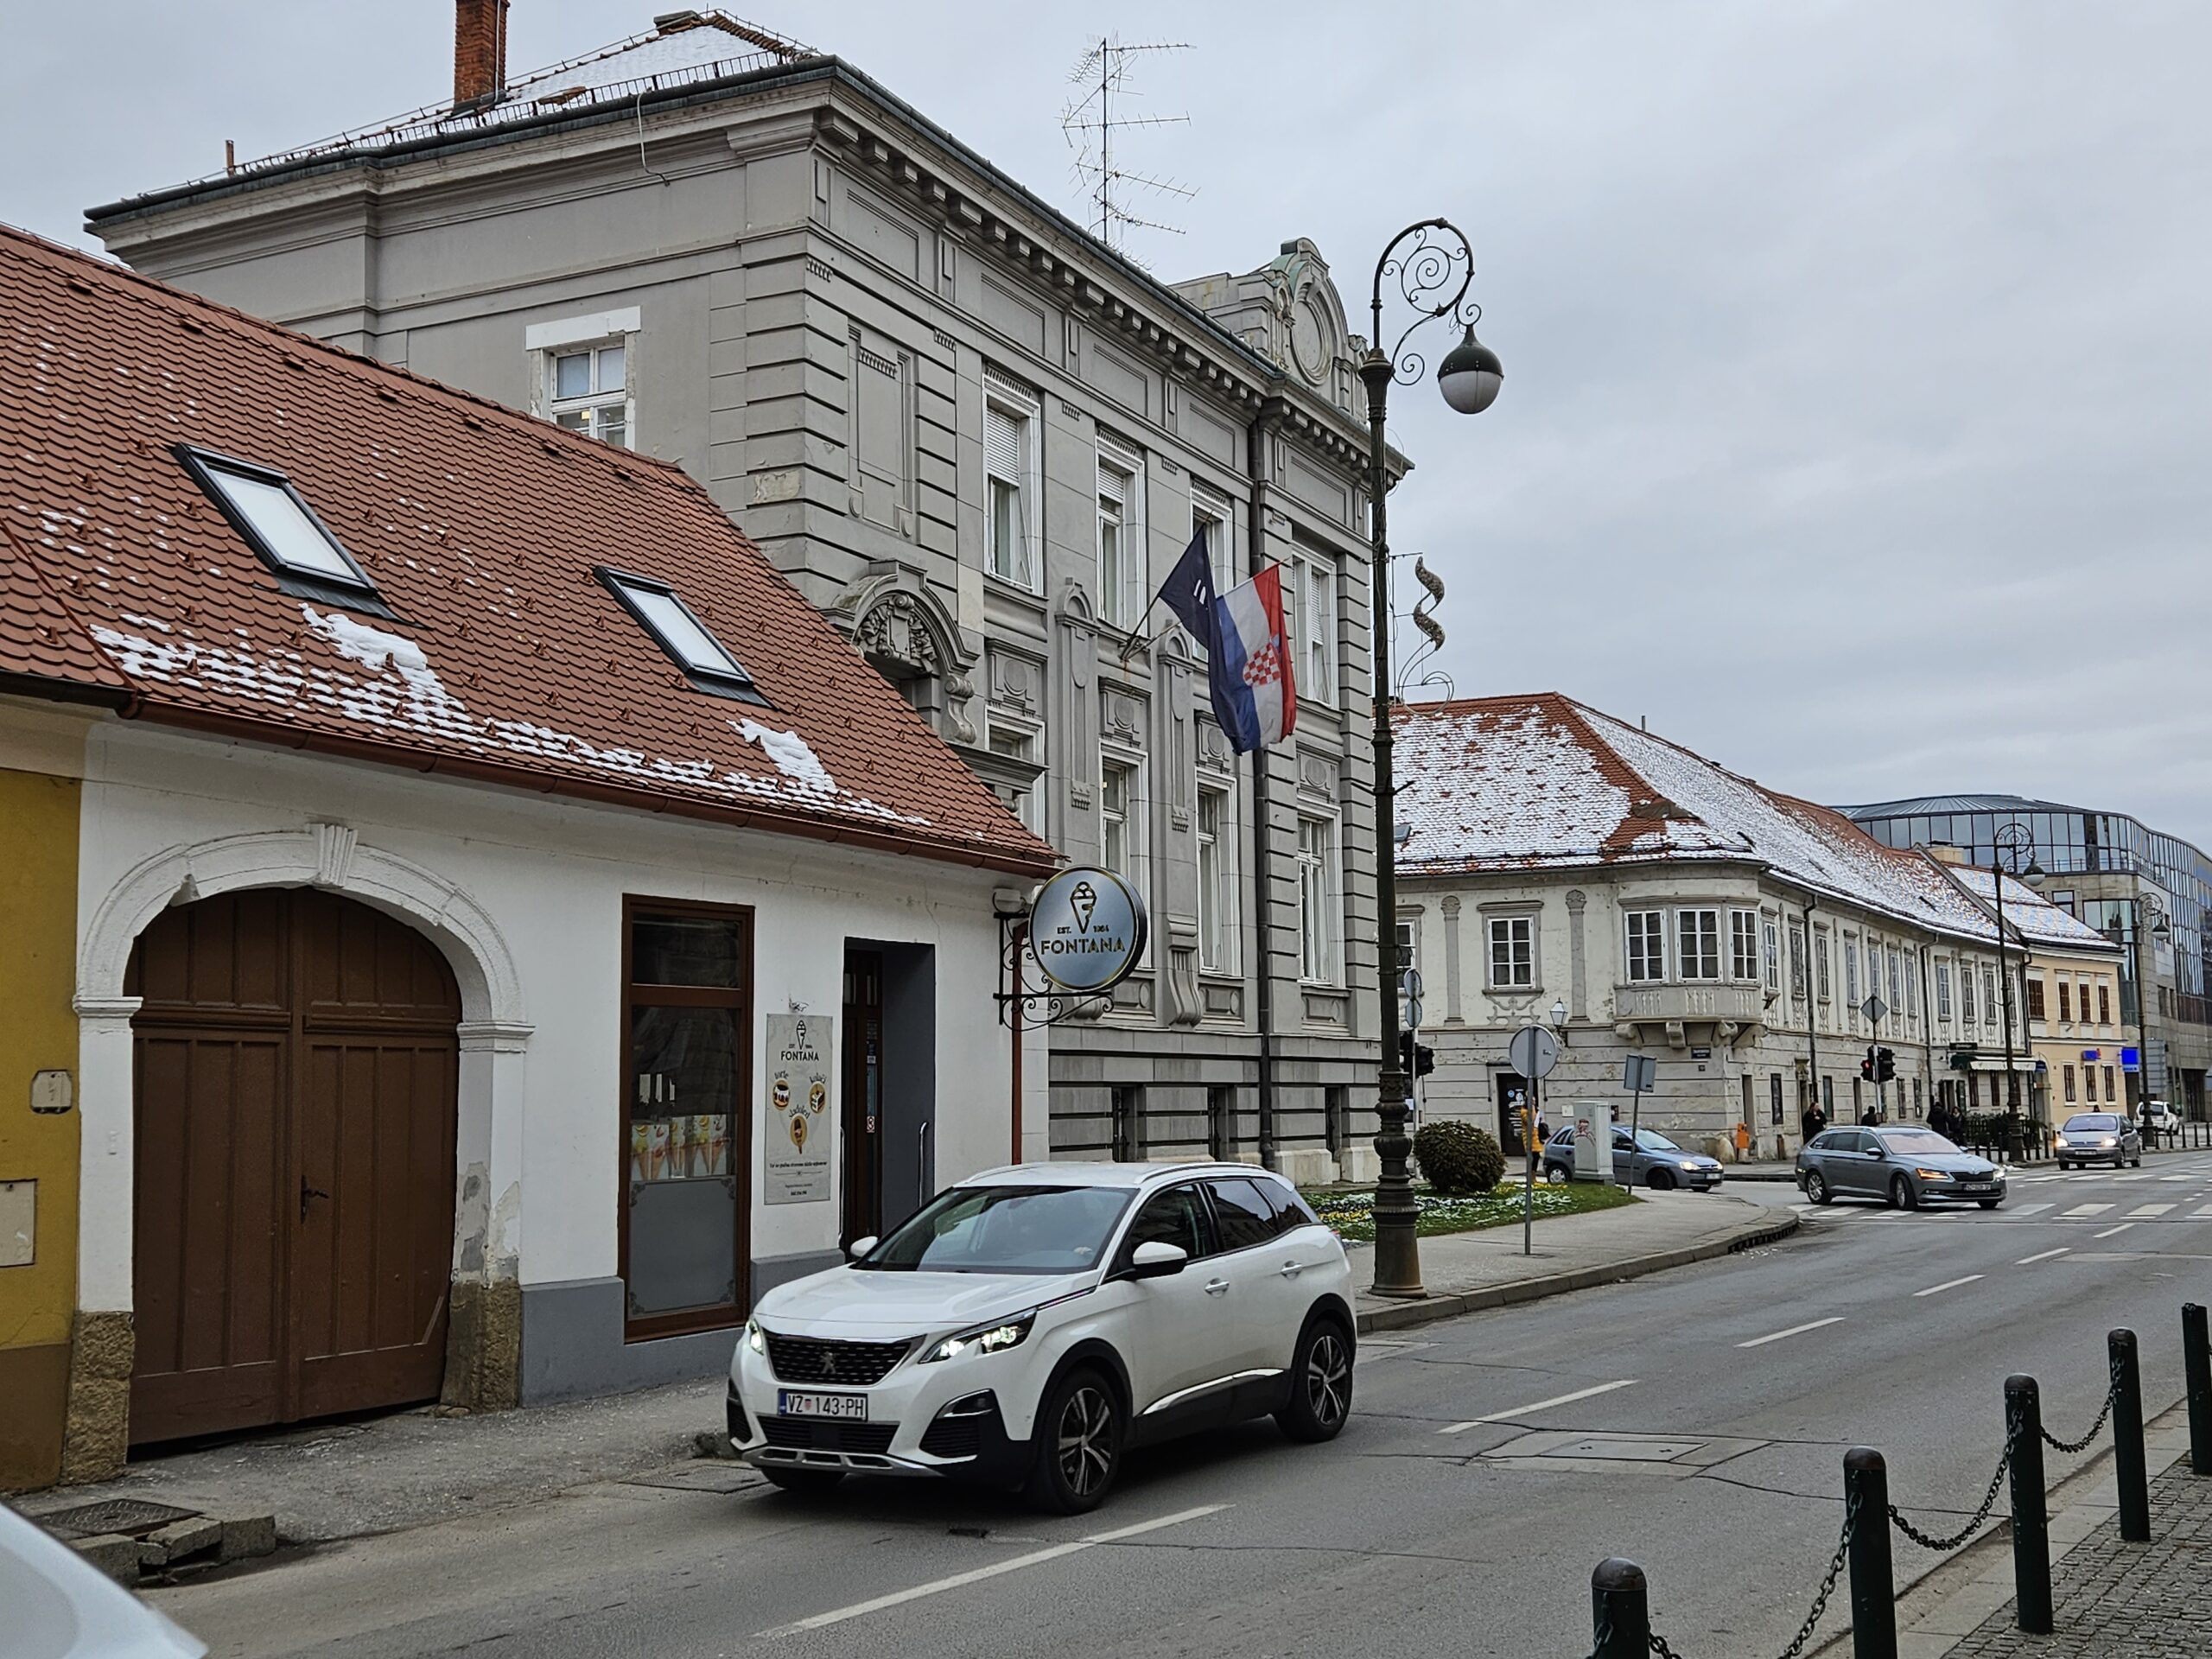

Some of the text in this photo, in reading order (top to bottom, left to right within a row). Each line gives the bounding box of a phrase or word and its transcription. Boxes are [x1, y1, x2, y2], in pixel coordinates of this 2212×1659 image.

[1041, 938, 1125, 955] FONTANA
[781, 1051, 819, 1061] FONTANA
[788, 1395, 864, 1416] VZ 143-PH
